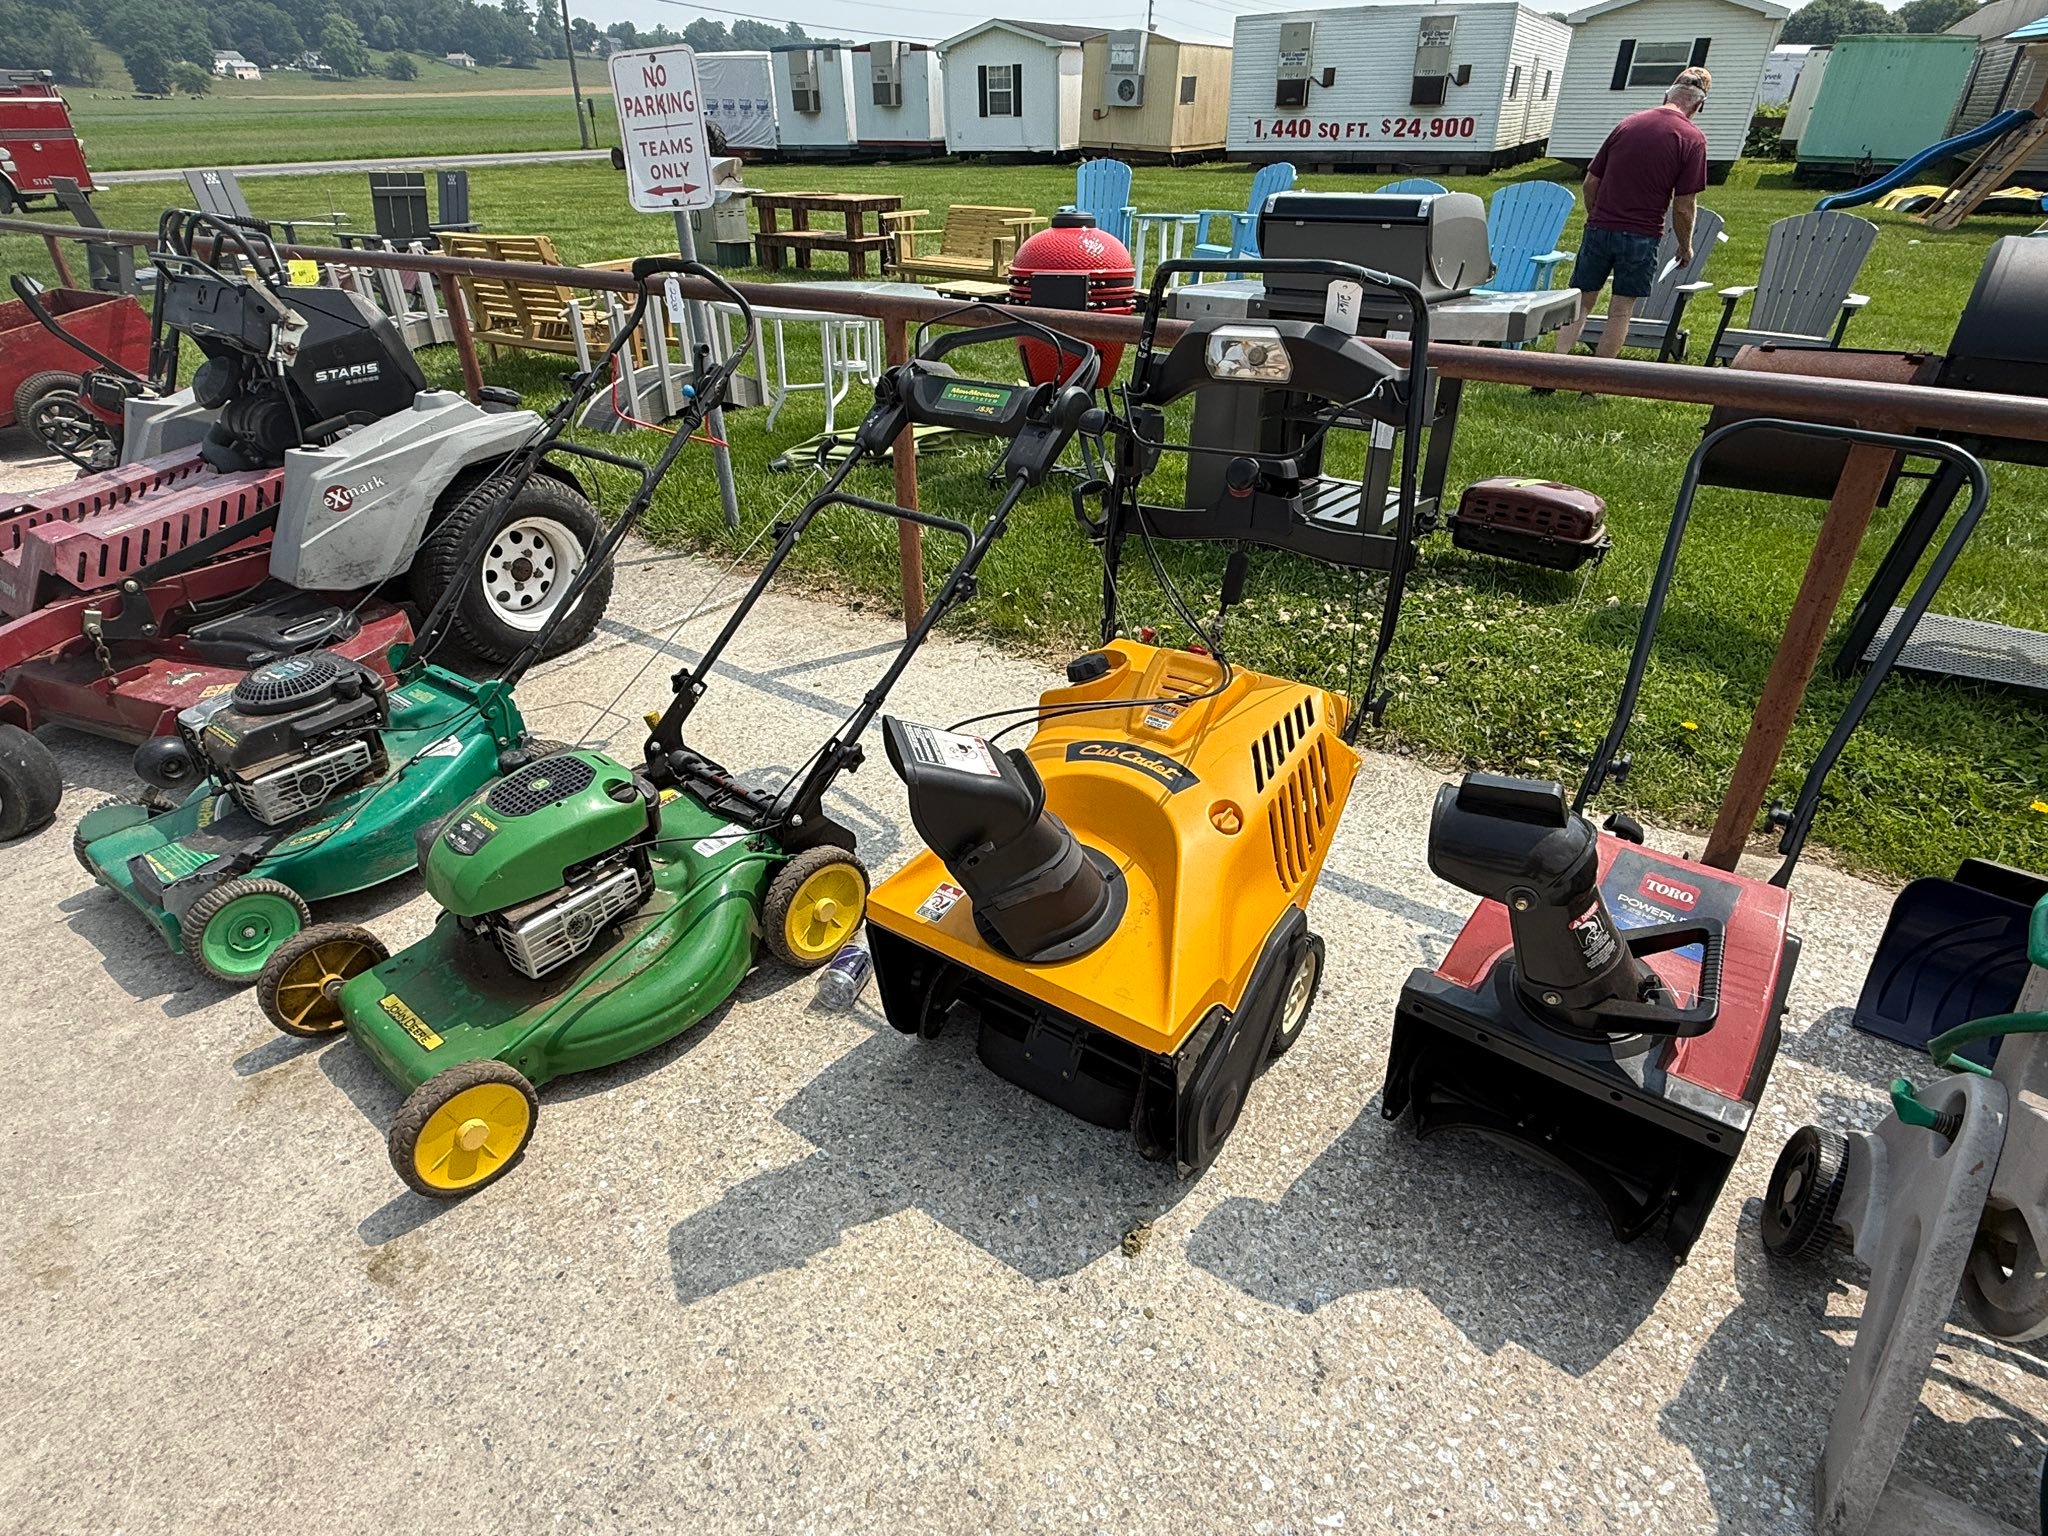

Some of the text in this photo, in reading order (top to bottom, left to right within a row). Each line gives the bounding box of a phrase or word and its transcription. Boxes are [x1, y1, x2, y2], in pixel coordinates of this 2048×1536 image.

[642, 64, 667, 88] NO
[623, 90, 695, 119] PARKING
[1254, 117, 1475, 141] 1,440 SQ FT. $24,900
[639, 137, 693, 157] TEAMS
[650, 161, 690, 180] ONLY
[315, 362, 379, 382] STARIS
[1079, 744, 1182, 781] Cub Cadet
[1647, 879, 1698, 904] TORO
[386, 1002, 431, 1043] JOHN DEERE
